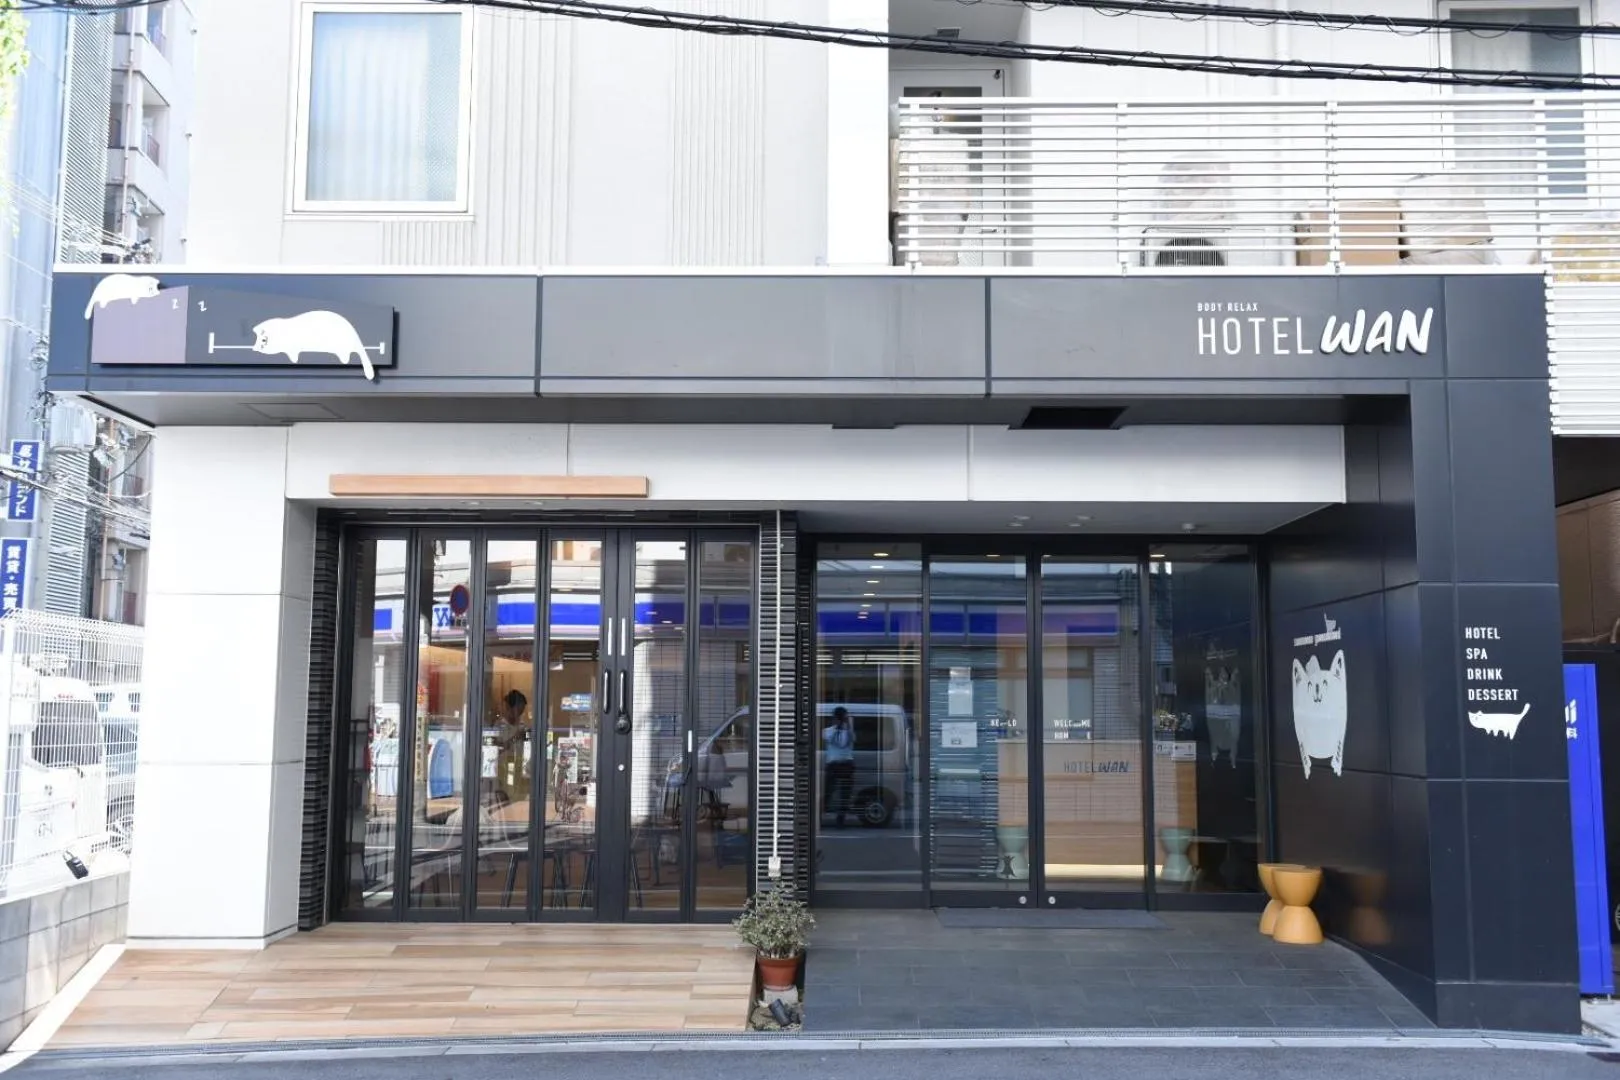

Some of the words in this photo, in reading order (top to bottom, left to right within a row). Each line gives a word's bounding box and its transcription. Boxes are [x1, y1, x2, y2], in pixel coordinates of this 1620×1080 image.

[1197, 302, 1222, 312] BODY
[1227, 302, 1258, 312] RELAX
[1198, 317, 1314, 355] HOTEL
[1320, 307, 1434, 355] WAN
[1465, 627, 1501, 640] HOTEL
[1466, 648, 1488, 660] SPA
[1467, 668, 1503, 680] DRINK
[1468, 689, 1519, 701] DESSERT
[1098, 759, 1129, 773] WAN
